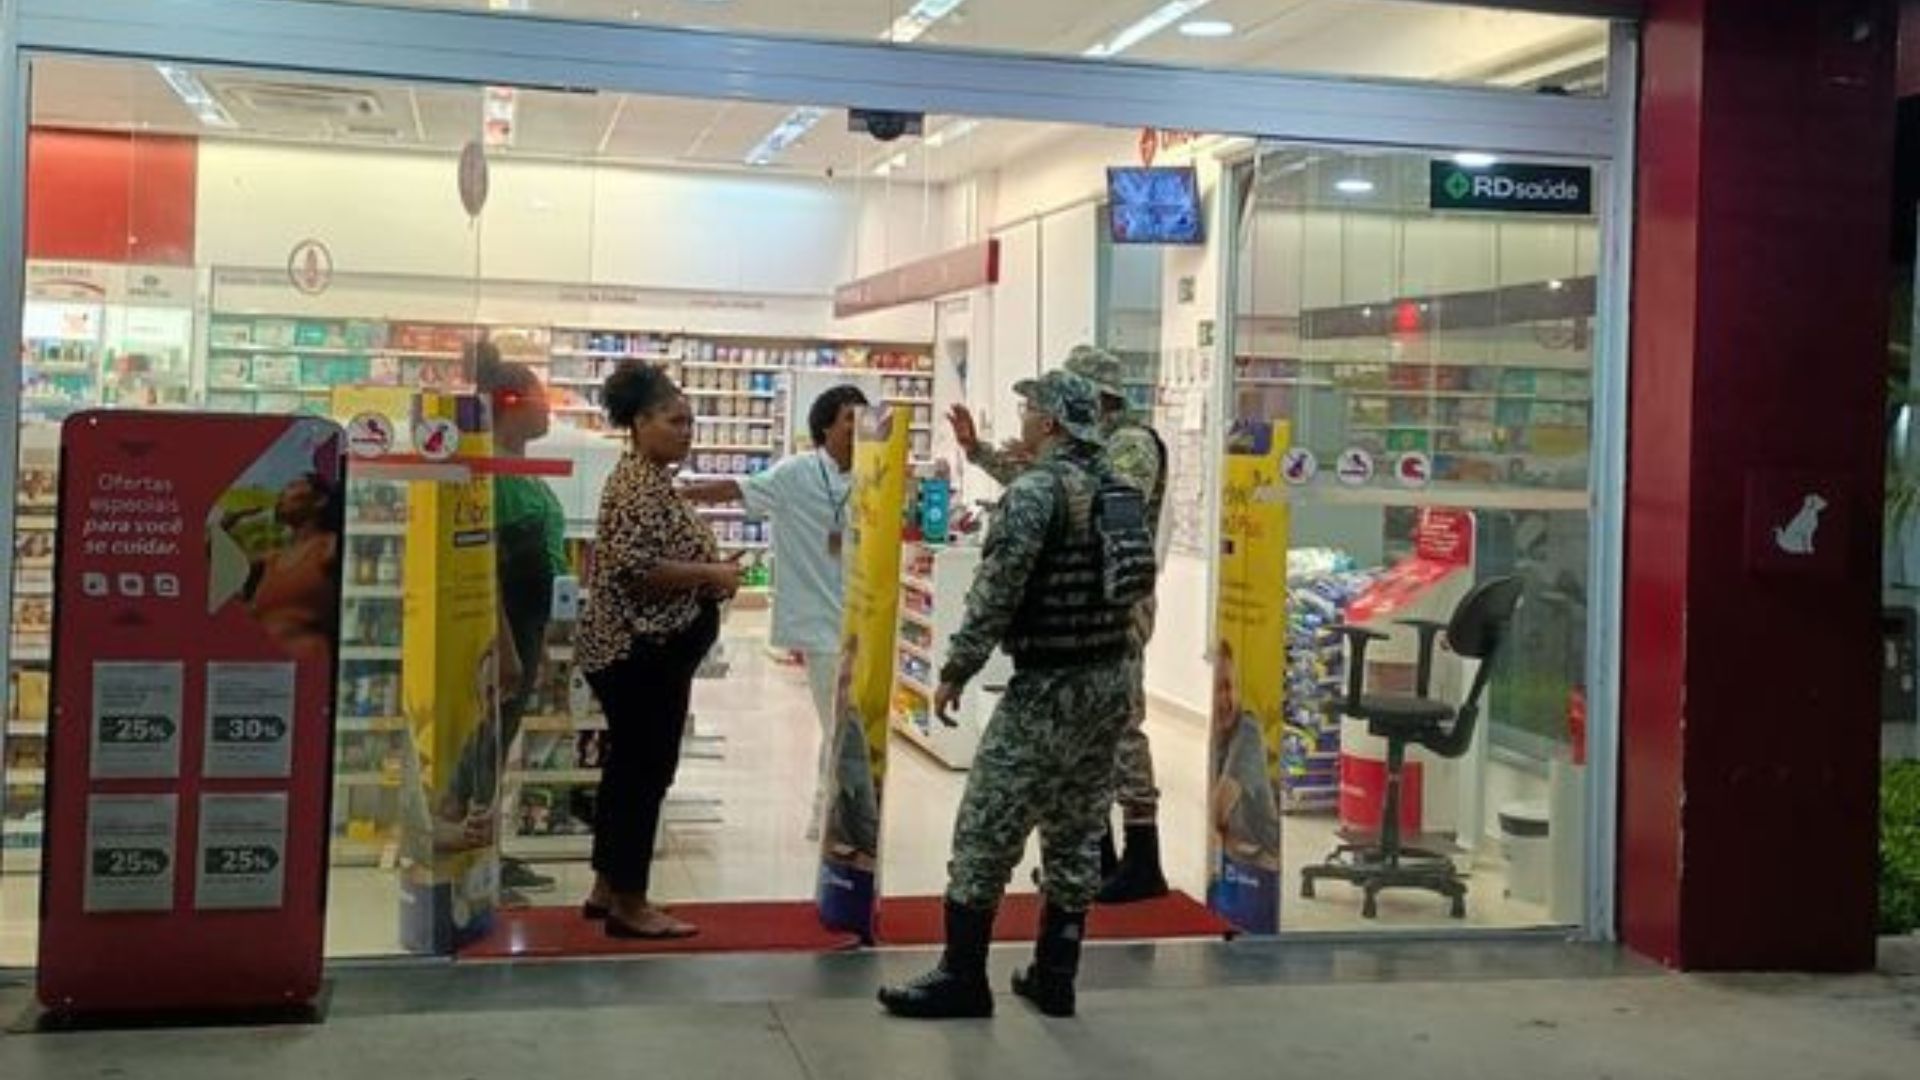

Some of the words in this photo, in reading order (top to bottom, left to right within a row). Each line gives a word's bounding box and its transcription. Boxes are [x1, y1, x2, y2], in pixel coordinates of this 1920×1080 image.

[98, 472, 174, 492] Ofertas
[89, 496, 180, 516] especiais
[82, 520, 130, 537] para
[133, 514, 183, 534] você
[84, 540, 107, 555] se
